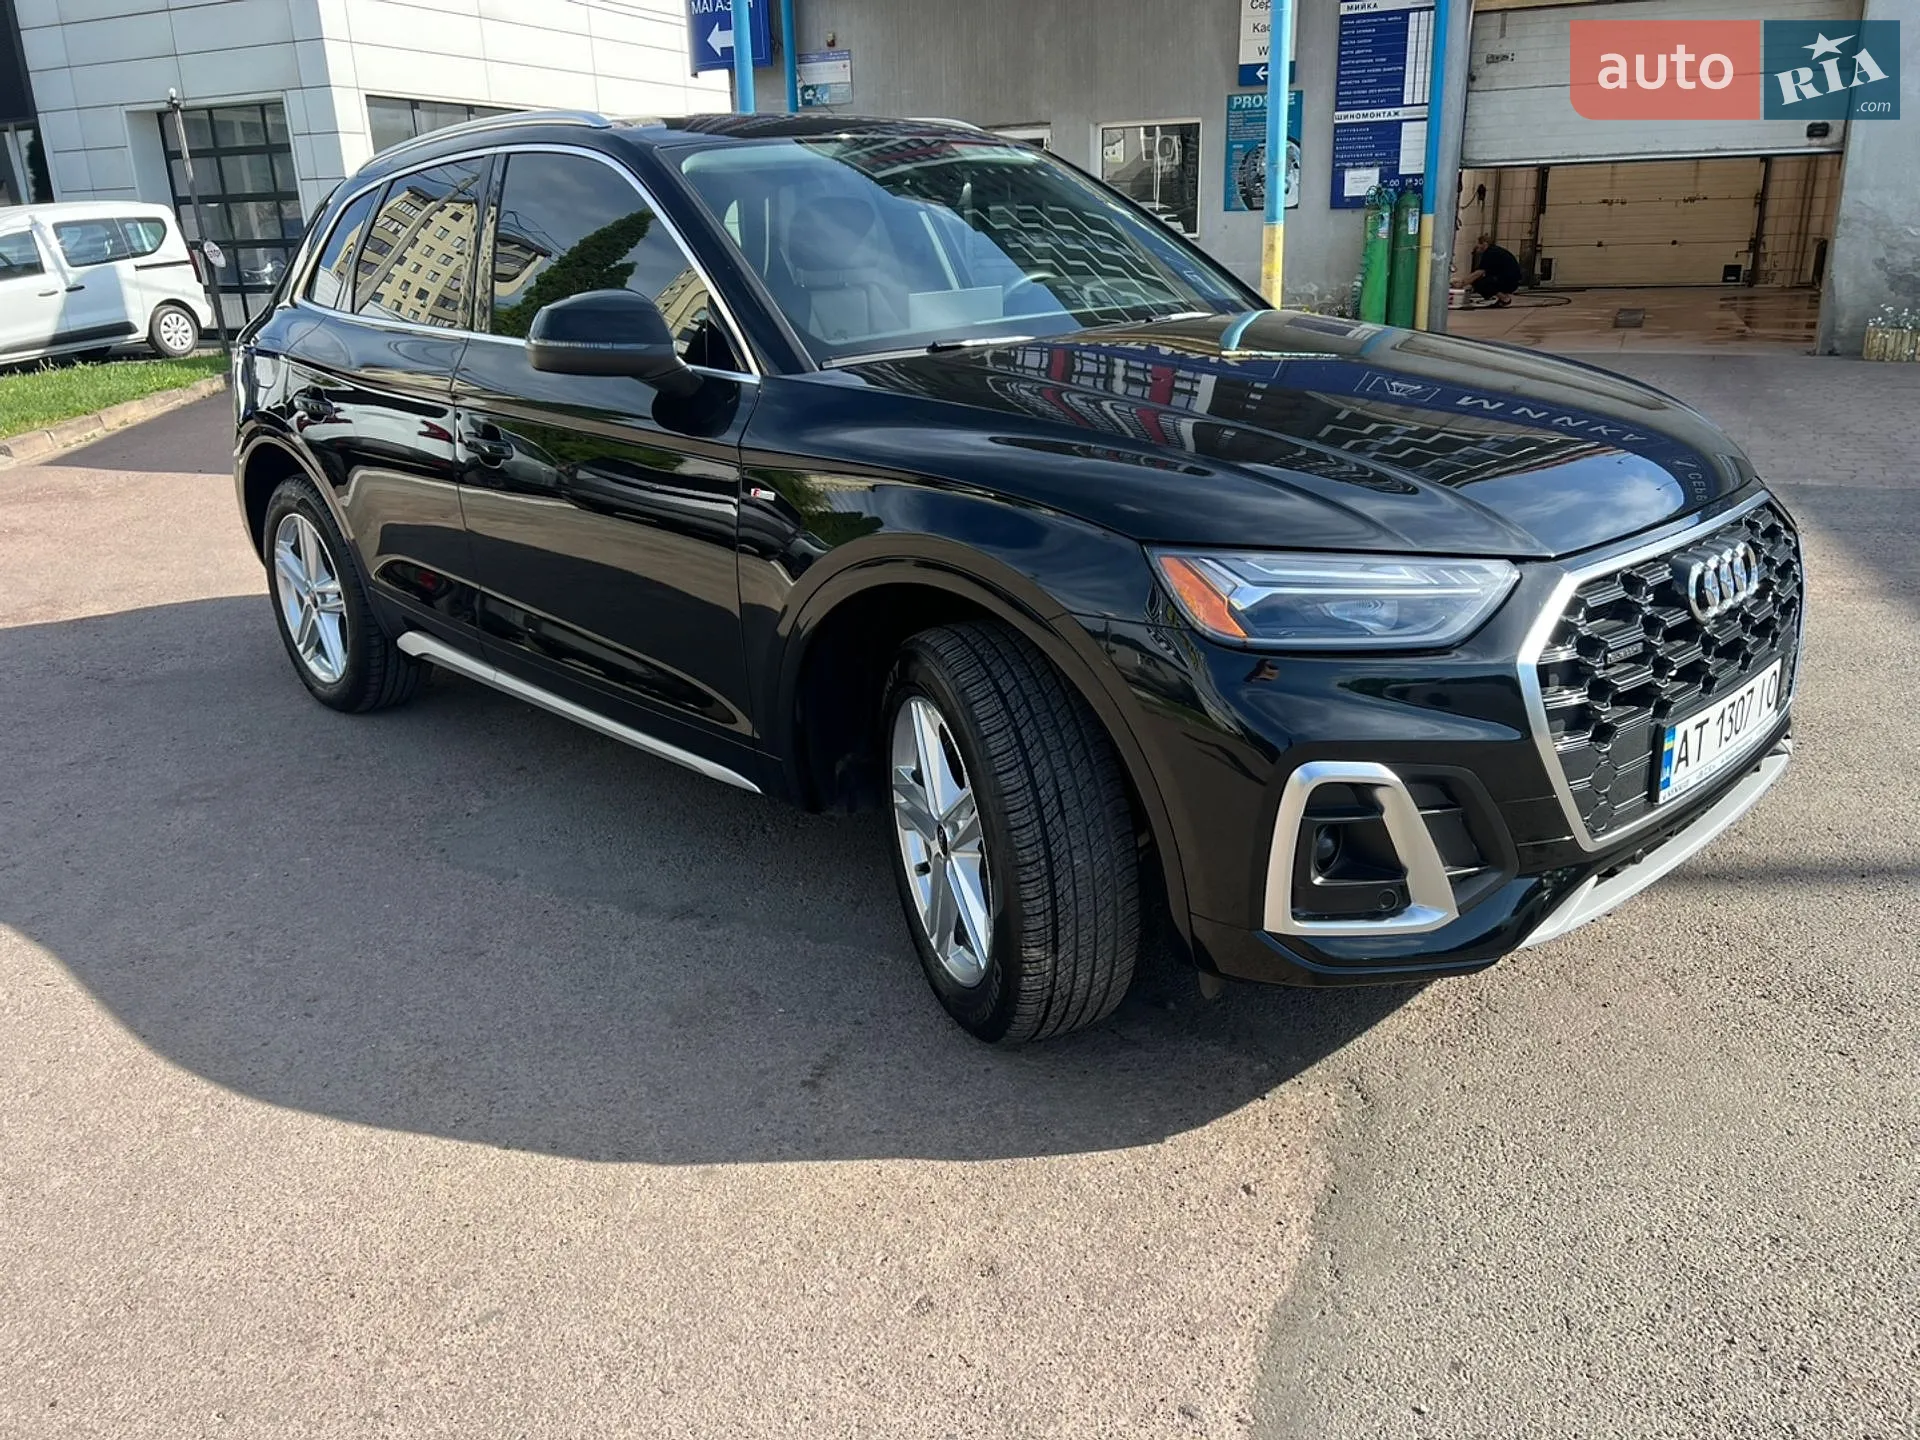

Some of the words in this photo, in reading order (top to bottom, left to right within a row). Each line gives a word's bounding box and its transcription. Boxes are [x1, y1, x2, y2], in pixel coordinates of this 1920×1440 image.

[1347, 2, 1378, 11] МИЙКА
[1334, 110, 1400, 121] ШИНОМОНТАЖ
[1674, 718, 1709, 774] AT
[1716, 687, 1754, 748] 1307
